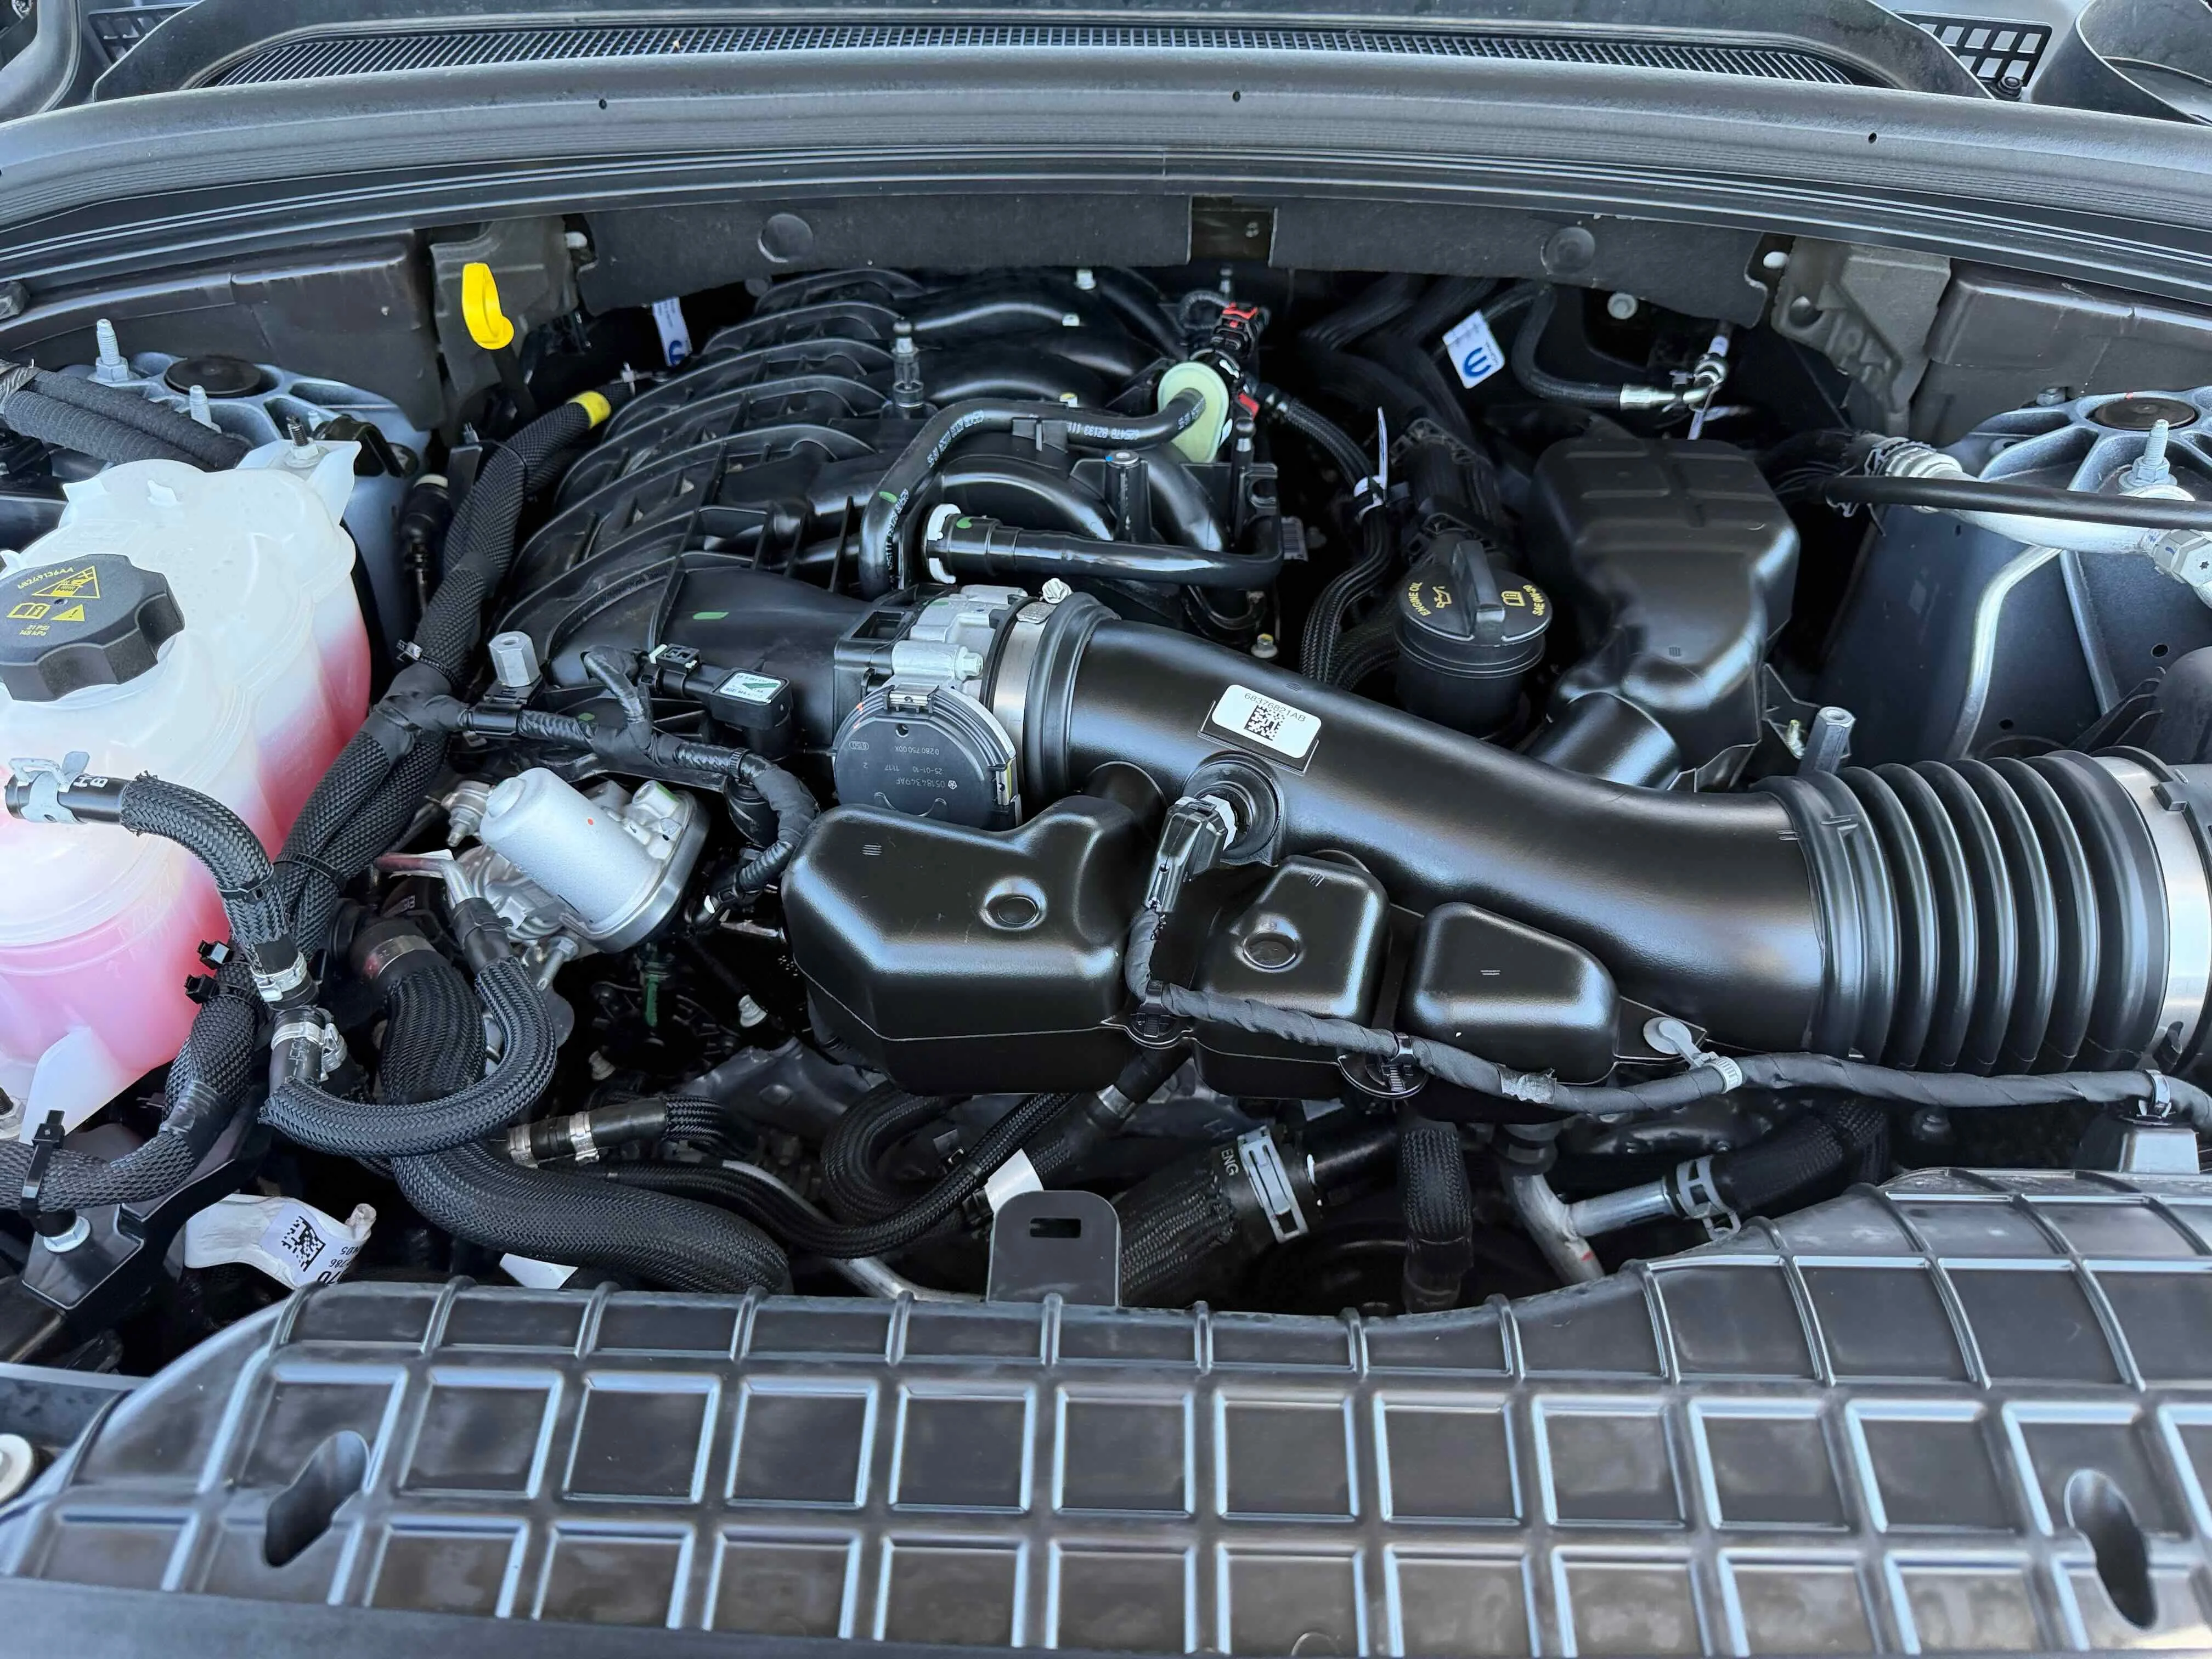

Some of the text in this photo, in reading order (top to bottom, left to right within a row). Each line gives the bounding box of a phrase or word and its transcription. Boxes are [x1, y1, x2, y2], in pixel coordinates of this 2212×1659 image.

[1408, 582, 1431, 617] ENGINE OIL
[1532, 602, 1545, 616] SAE
[1244, 692, 1306, 722] 68376821AB
[1221, 1148, 1239, 1176] ENG
